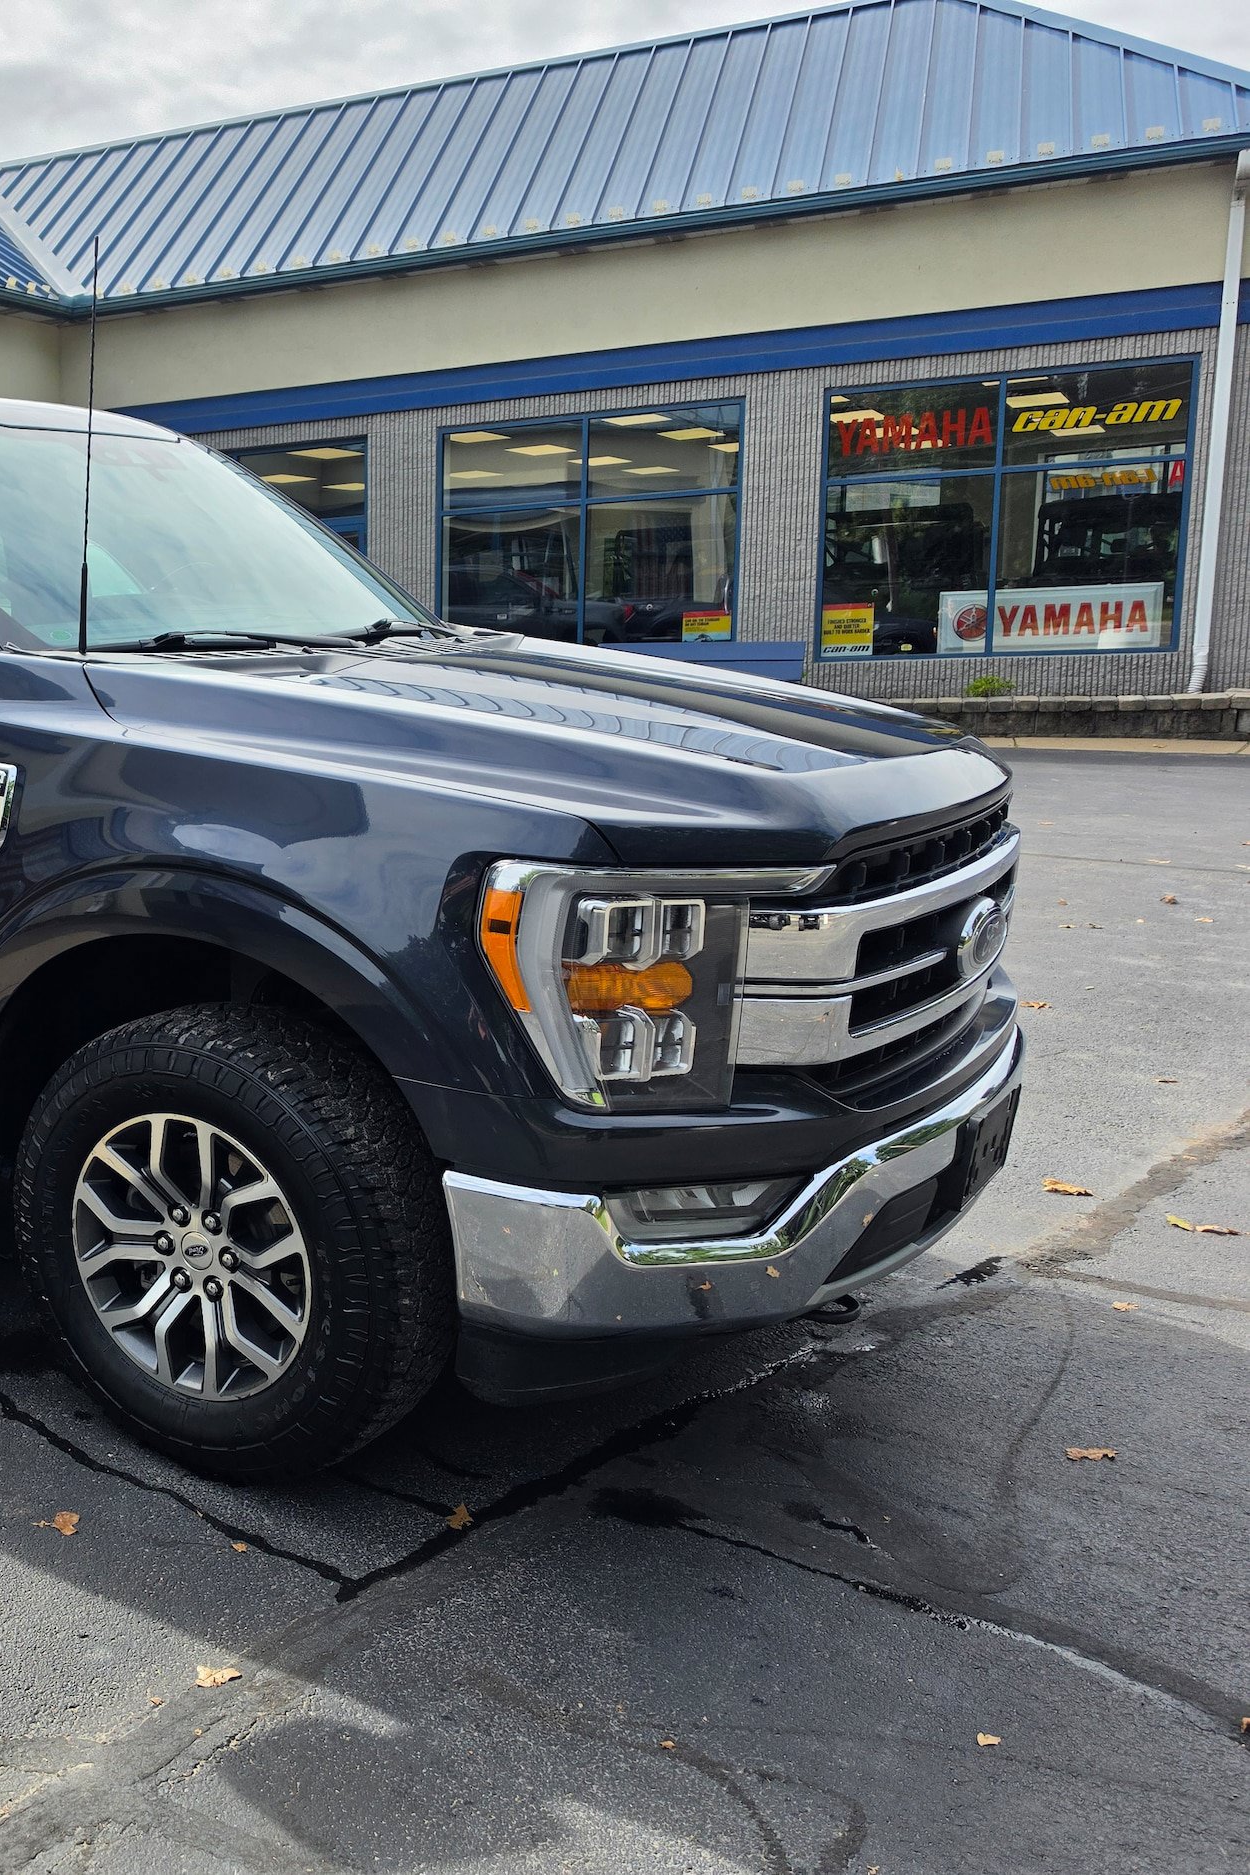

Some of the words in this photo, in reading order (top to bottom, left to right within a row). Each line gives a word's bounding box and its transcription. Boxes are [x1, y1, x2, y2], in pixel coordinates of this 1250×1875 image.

[836, 406, 994, 458] YAMAHA
[1012, 397, 1182, 433] can-am
[997, 599, 1148, 638] YAMAHA
